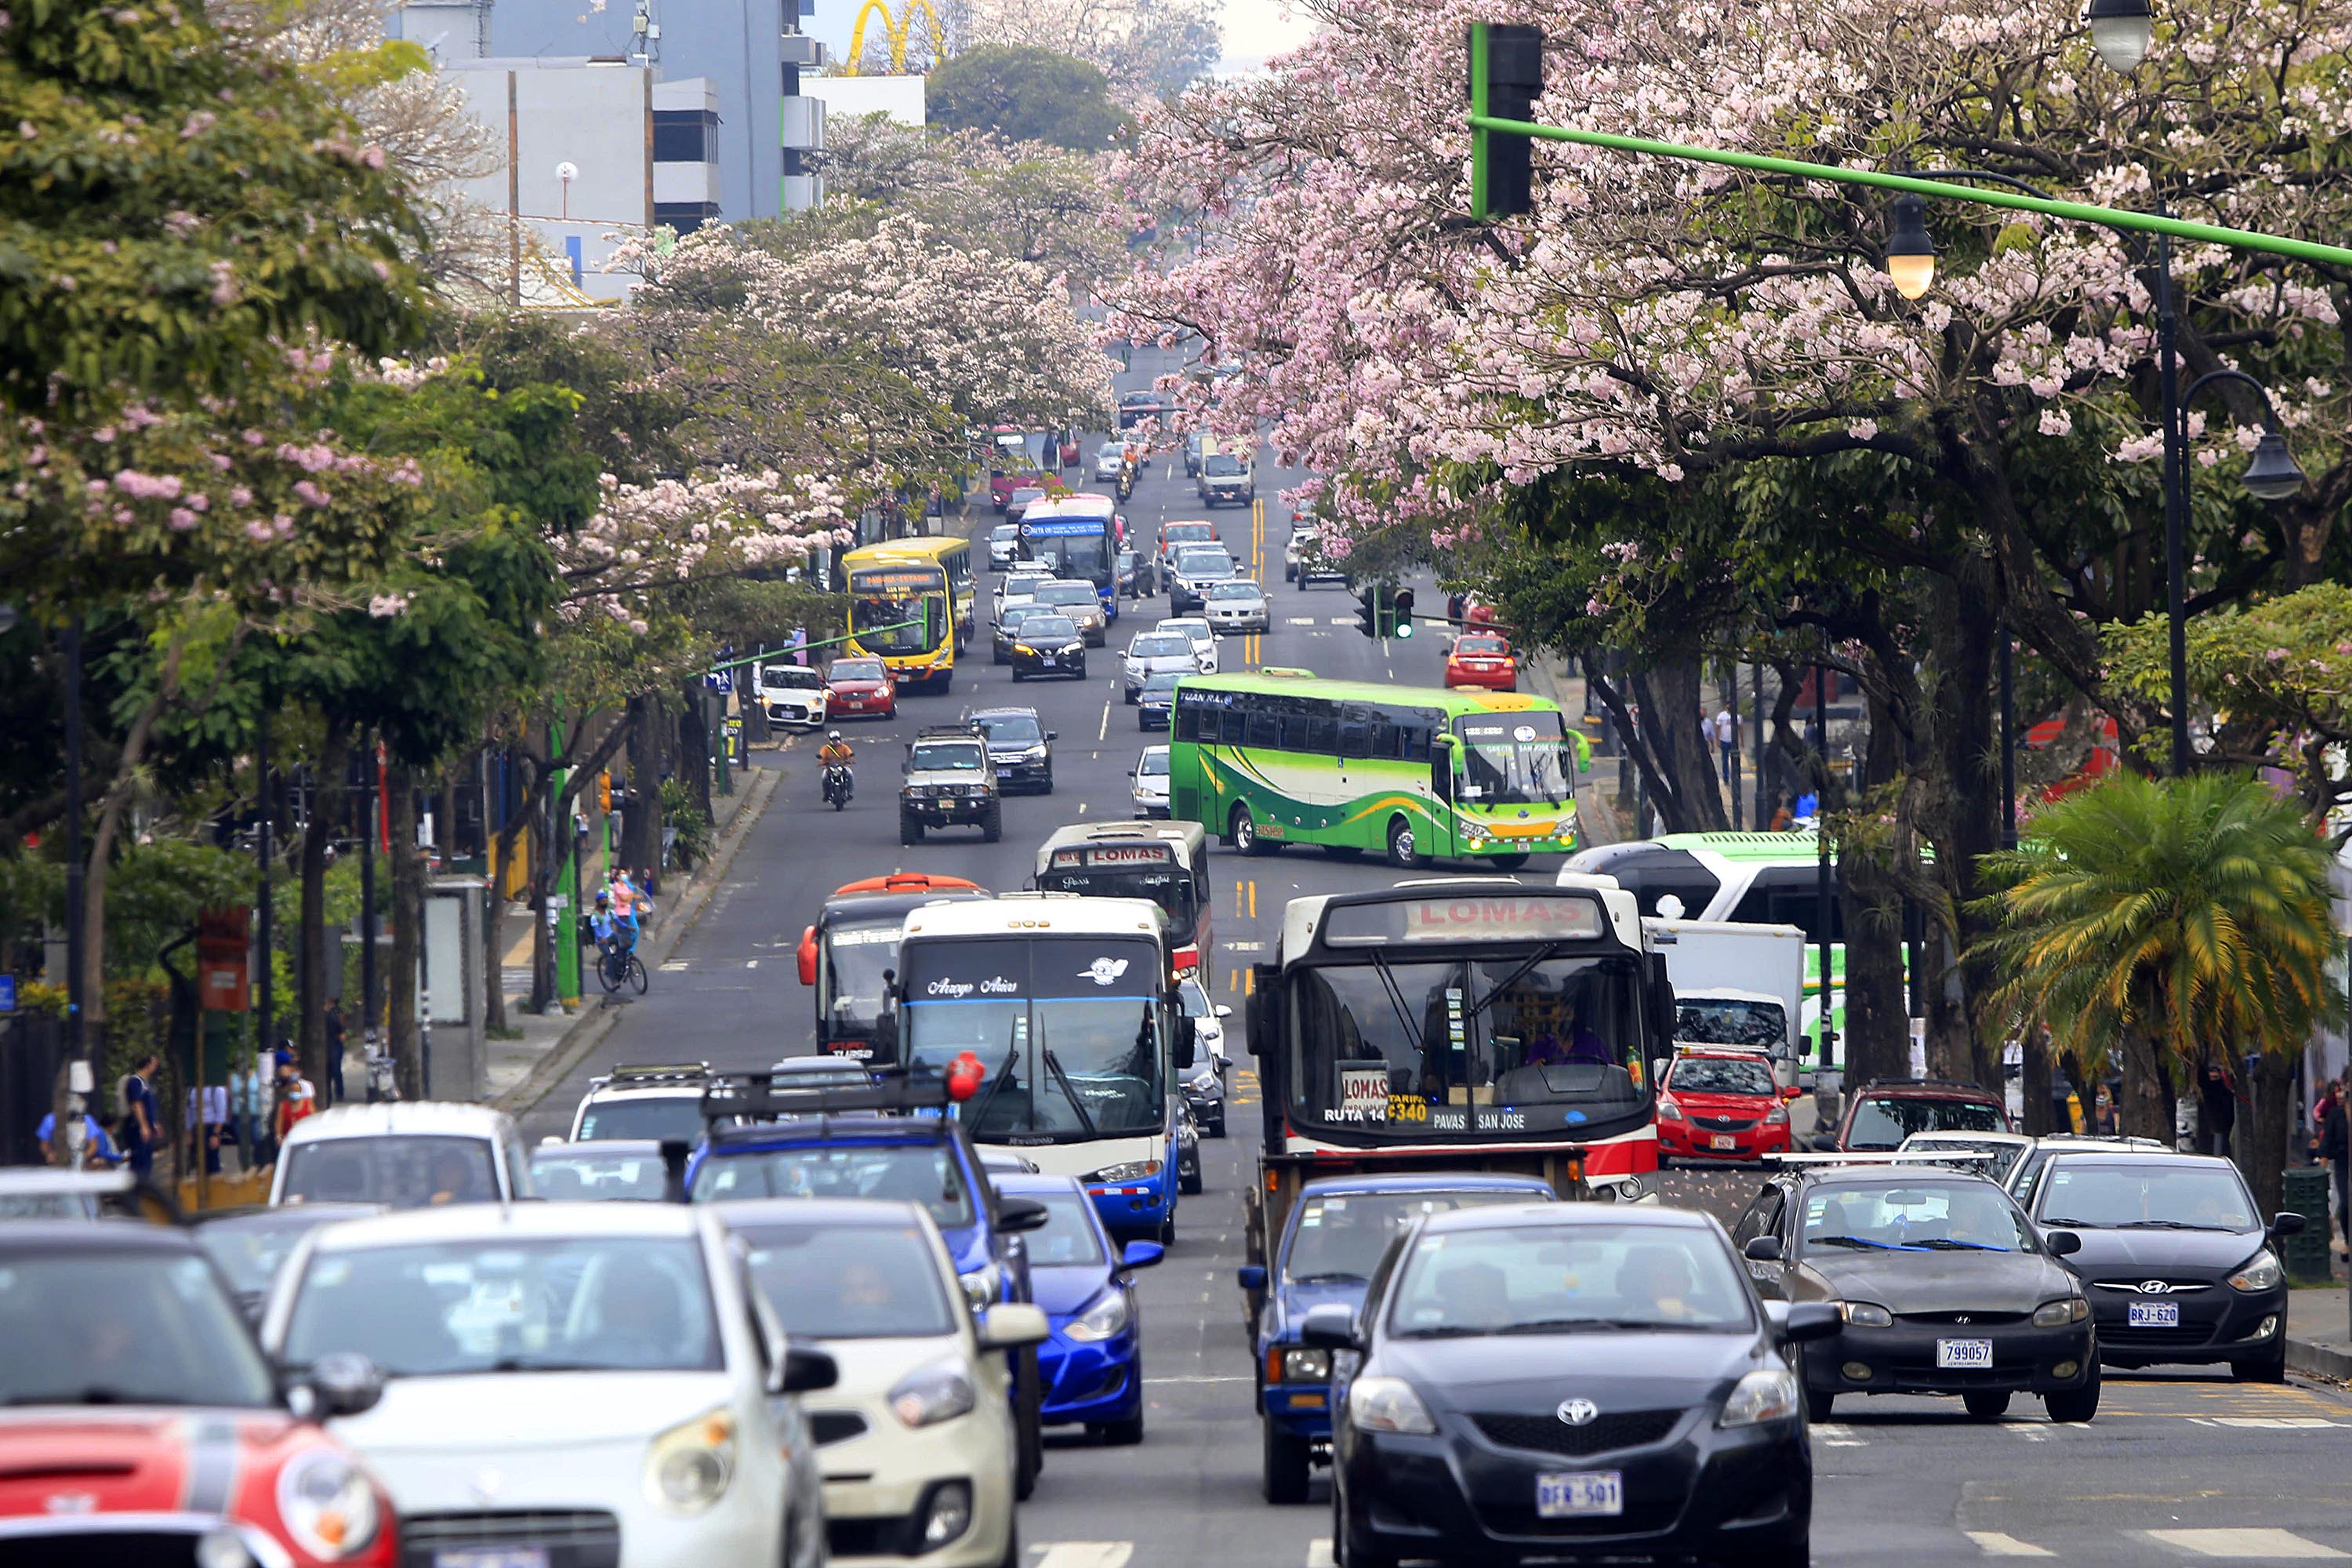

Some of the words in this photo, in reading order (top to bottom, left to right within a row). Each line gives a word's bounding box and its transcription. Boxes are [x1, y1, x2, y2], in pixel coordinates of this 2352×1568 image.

[1094, 848, 1163, 861] LOMAS
[1421, 899, 1581, 924] LOMAS
[1343, 1079, 1388, 1100] LOMAS
[1324, 1109, 1364, 1122] RUTA
[1369, 1109, 1386, 1122] 14
[1434, 1114, 1465, 1130] PAVAS
[1478, 1114, 1498, 1129] SAN
[1500, 1114, 1525, 1129] JOSE
[2131, 1308, 2176, 1321] BRJ-620
[1947, 1345, 1989, 1360] 799057
